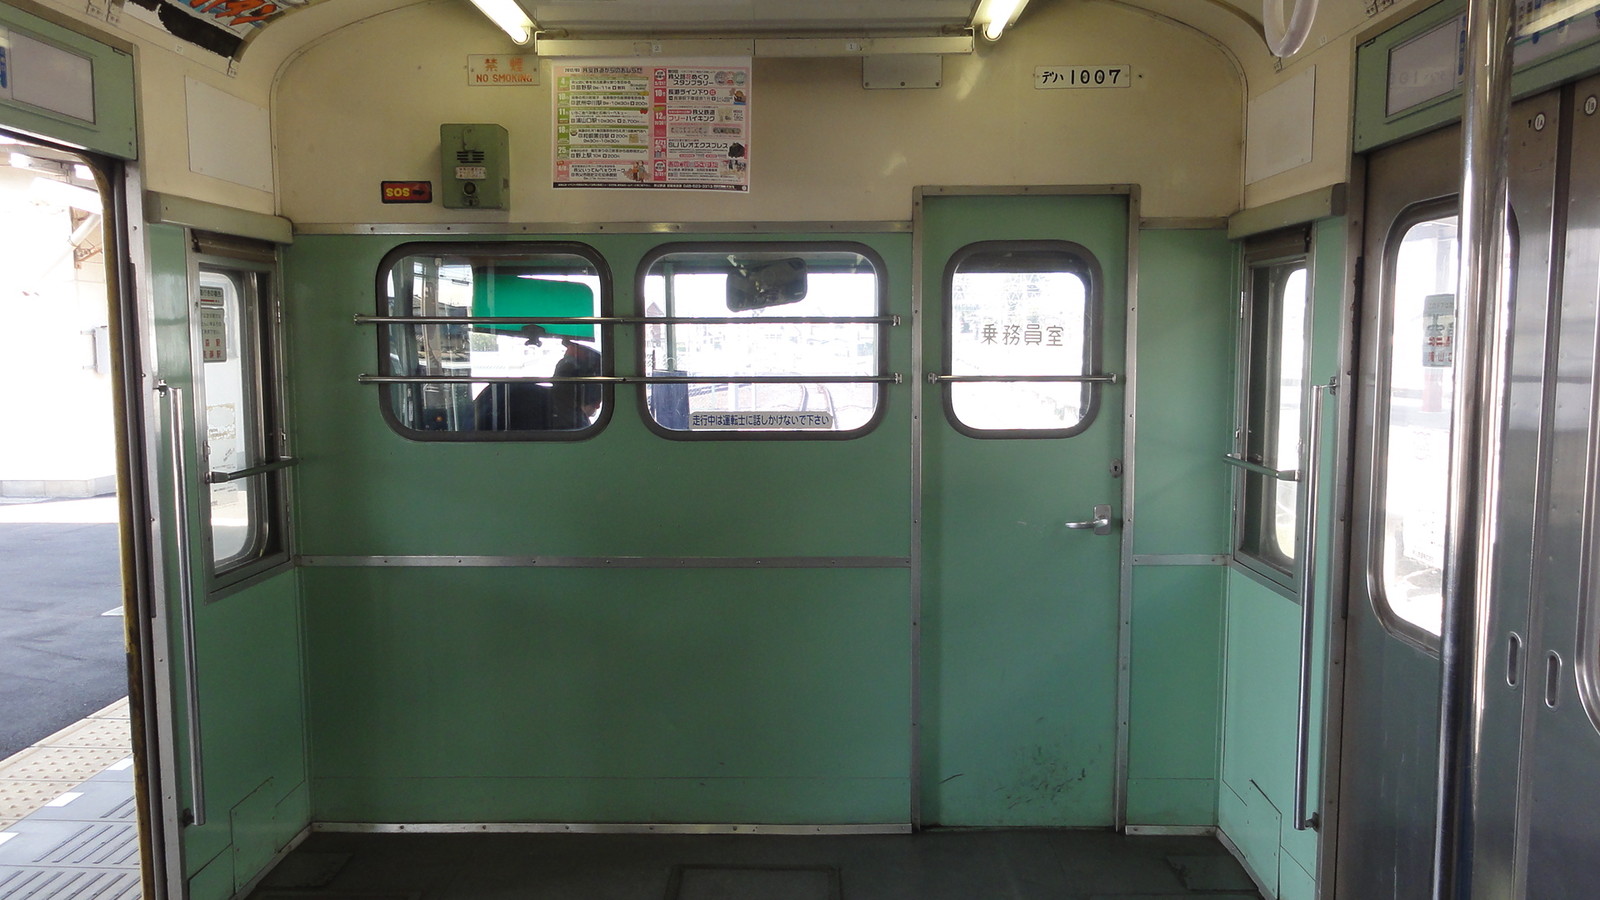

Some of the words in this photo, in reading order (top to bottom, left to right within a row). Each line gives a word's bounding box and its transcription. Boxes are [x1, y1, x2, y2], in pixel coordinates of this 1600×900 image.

[476, 74, 489, 83] NO
[493, 74, 533, 84] SMOKING
[1042, 71, 1064, 84] デハ
[1071, 69, 1121, 85] 1007
[386, 187, 410, 197] SOS
[981, 323, 1064, 346] 乗務員室
[692, 414, 829, 426] 走行中は運転士に話しかけないで下さい
